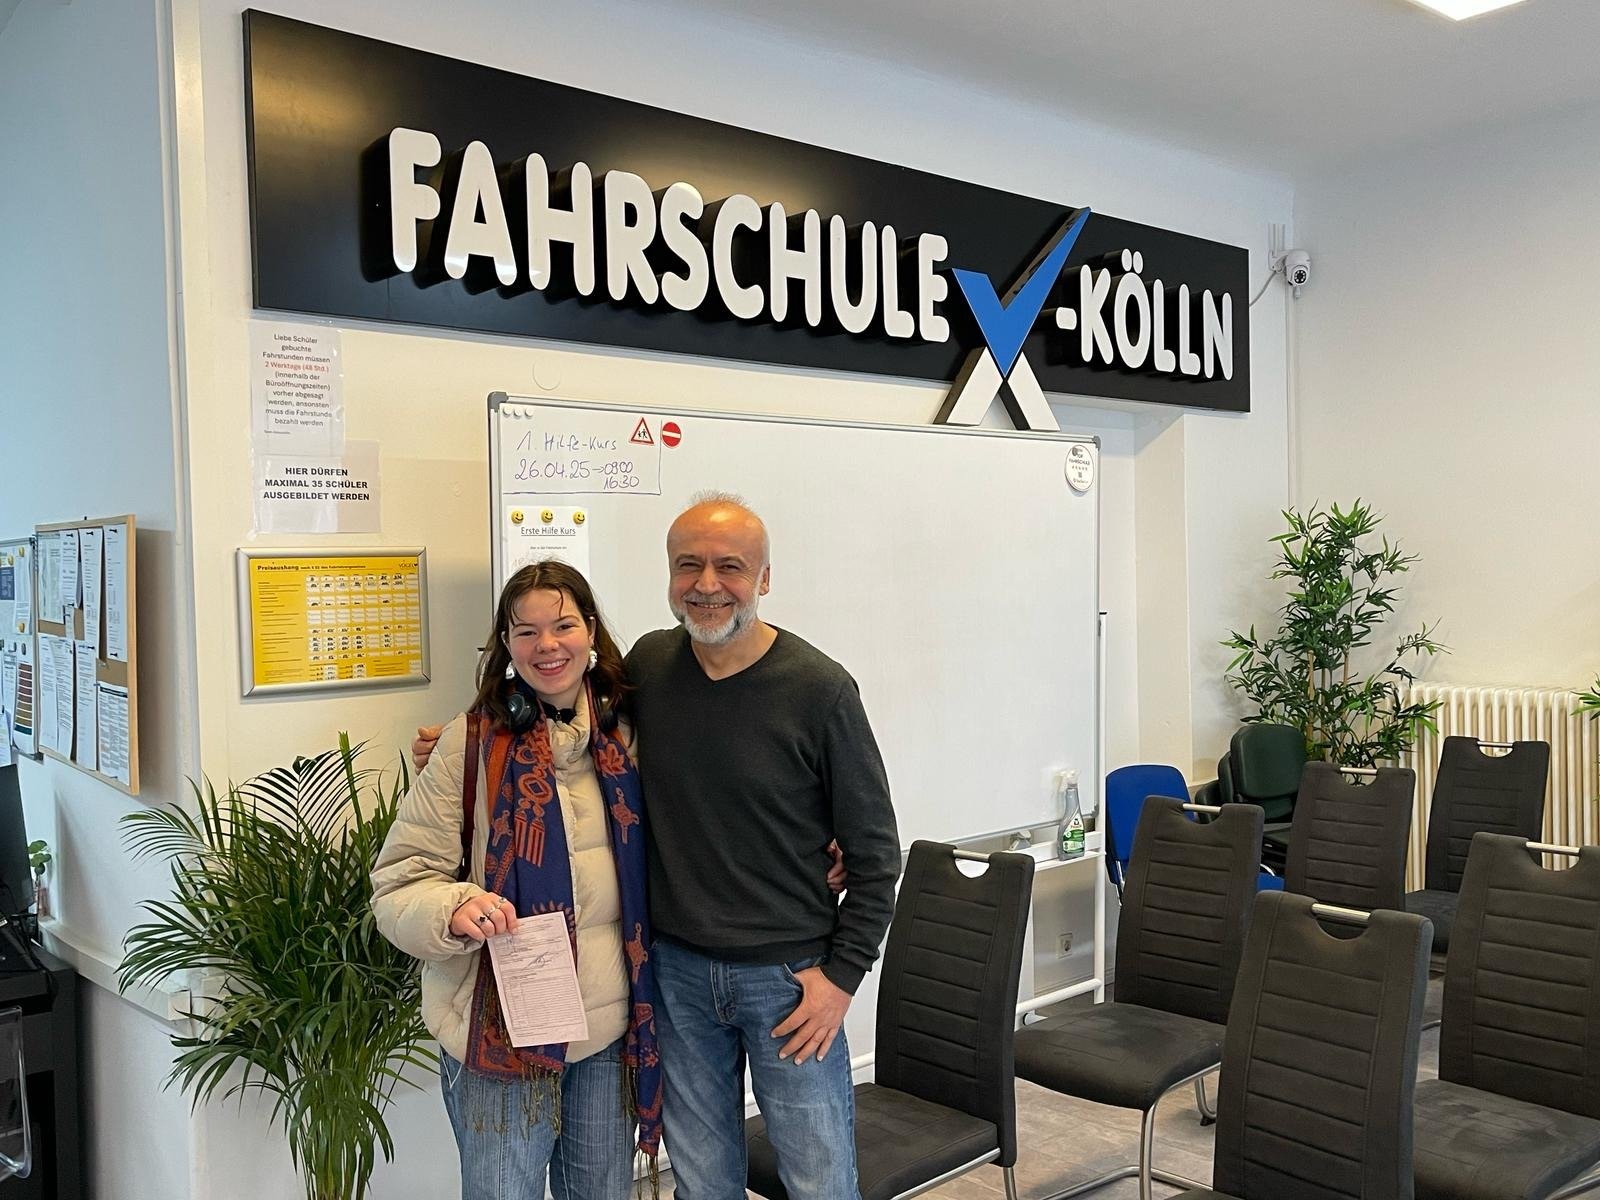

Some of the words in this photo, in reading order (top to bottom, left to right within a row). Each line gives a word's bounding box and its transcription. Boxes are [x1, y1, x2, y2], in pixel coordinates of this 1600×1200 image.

[389, 127, 950, 343] FAHRSCHULE
[273, 333, 292, 341] Liebe
[293, 335, 318, 344] Schüler
[281, 345, 312, 353] gebuchte
[262, 351, 304, 361] Fahrstunden
[305, 355, 331, 363] müssen
[275, 371, 308, 380] (innerhalb
[265, 379, 331, 391] Büroöffnungszeiten)
[295, 391, 324, 400] abgesagt
[296, 409, 333, 418] Fahrstunde
[300, 419, 324, 427] werden
[285, 467, 308, 475] HIER
[310, 466, 348, 476] DÜRFEN
[514, 458, 590, 480] 26.04.25
[264, 479, 309, 487] MAXIMAL
[312, 480, 323, 488] 35
[325, 480, 368, 489] SCHÜLER
[263, 491, 329, 500] AUSGEBILDET
[331, 492, 370, 501] WERDEN
[520, 526, 540, 535] Erste
[541, 527, 558, 535] Hilfe
[560, 527, 576, 535] Kurs
